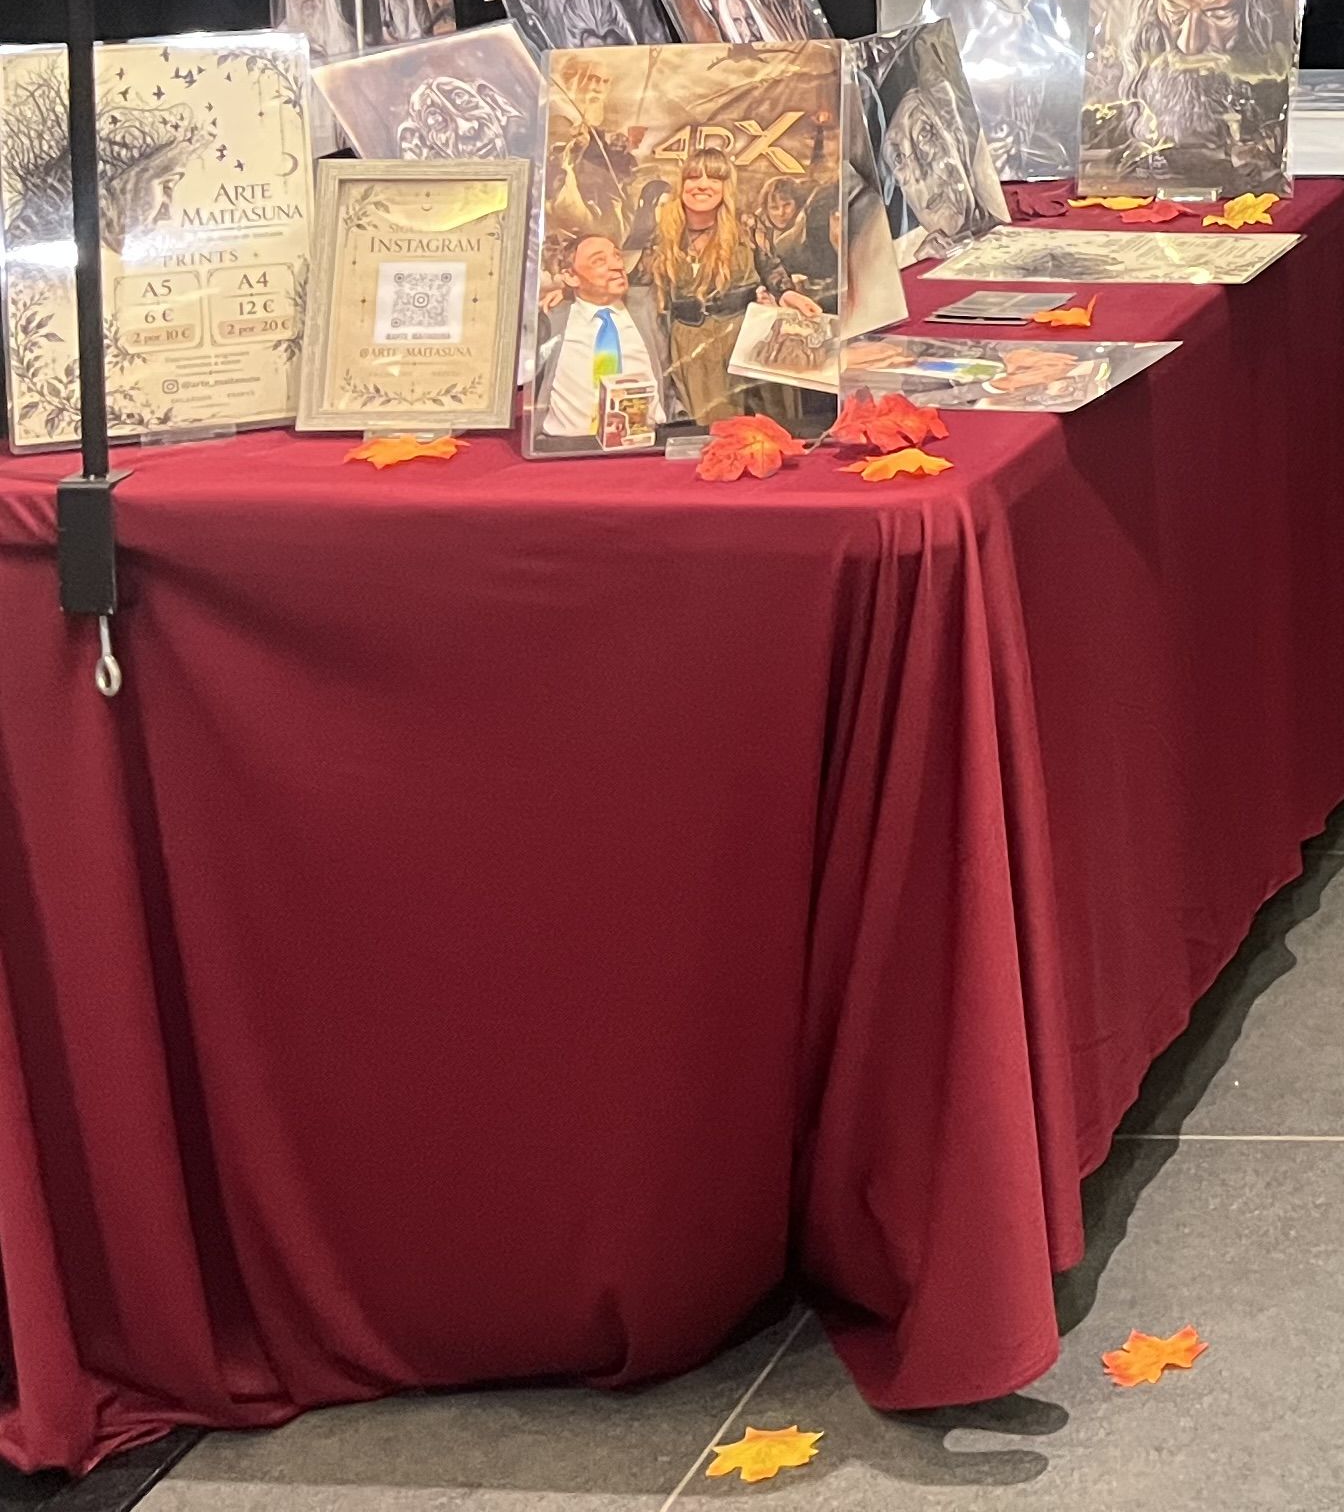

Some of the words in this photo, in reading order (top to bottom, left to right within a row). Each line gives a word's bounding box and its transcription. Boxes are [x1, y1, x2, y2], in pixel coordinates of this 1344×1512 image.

[214, 182, 273, 207] ARTE
[180, 204, 304, 228] MAITASUNA
[370, 236, 481, 253] INSTAGRAM
[163, 248, 239, 267] PRINTS
[142, 279, 173, 298] A5
[237, 271, 269, 289] A4
[238, 300, 257, 316] 12
[144, 310, 156, 324] 6
[226, 324, 236, 336] 2
[261, 319, 279, 332] 20
[132, 332, 142, 344] 2
